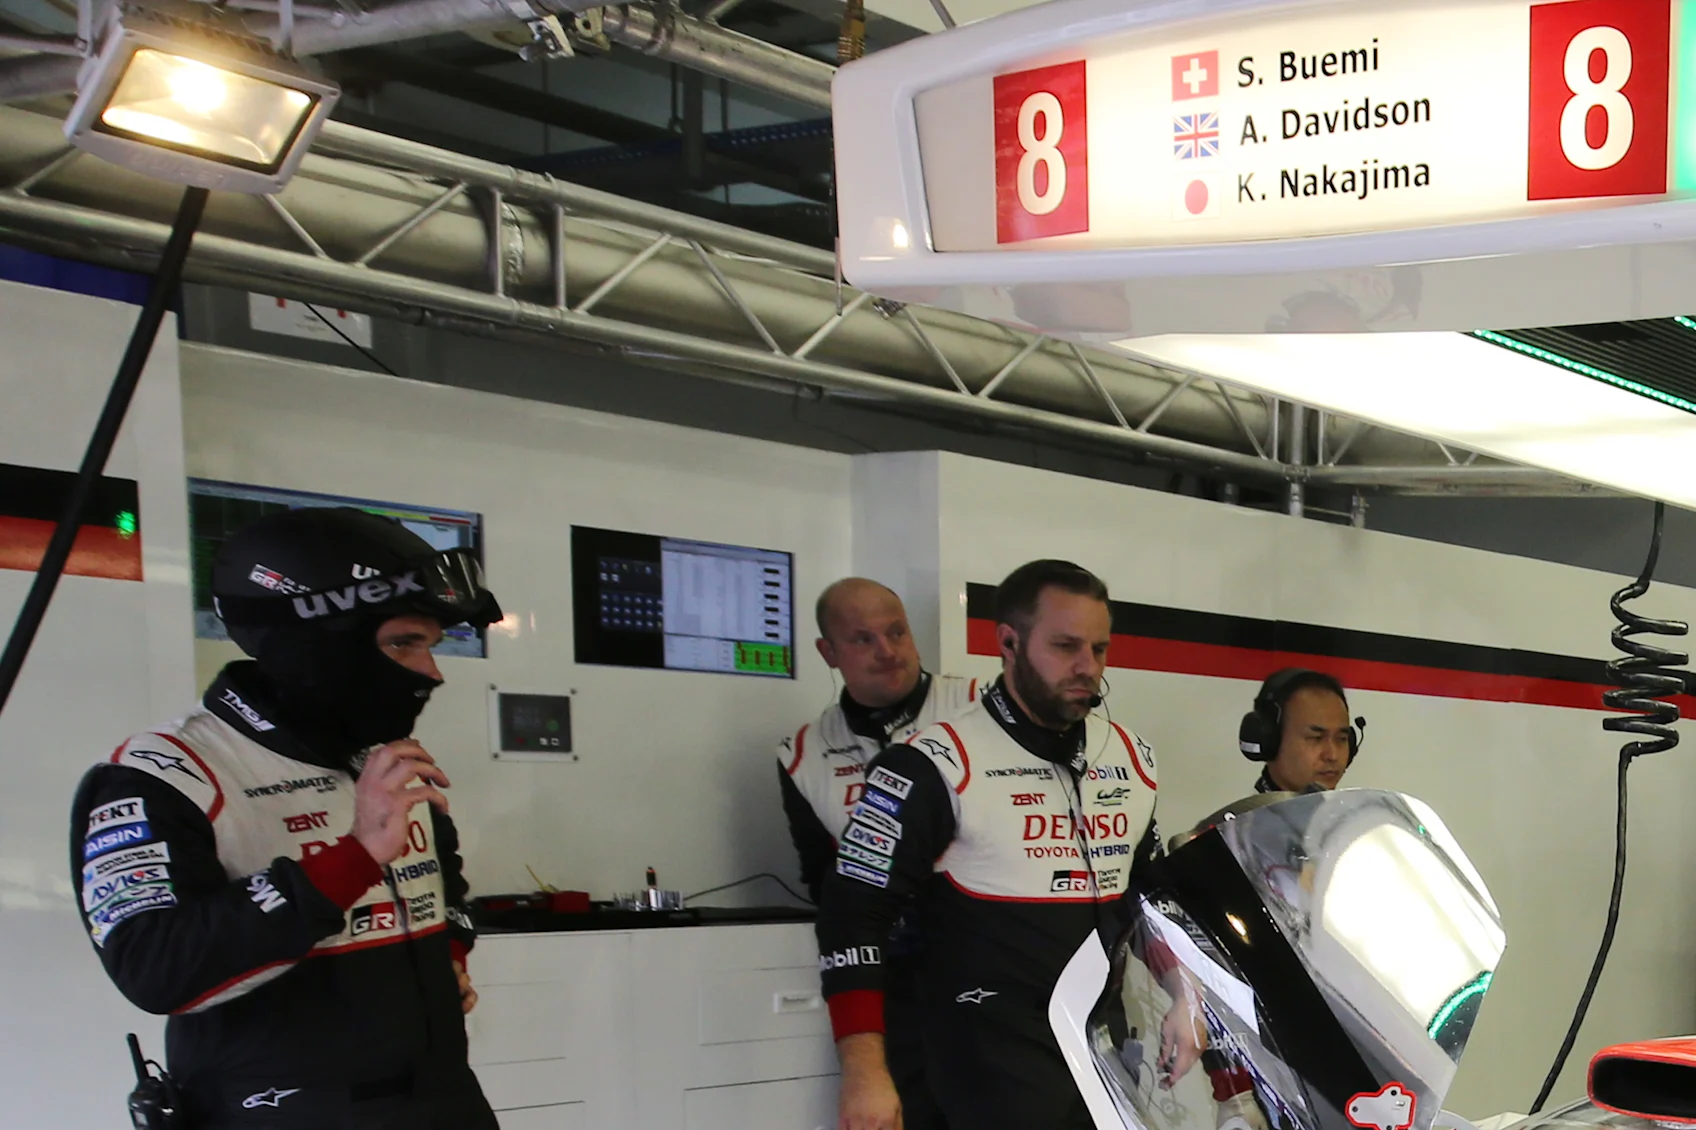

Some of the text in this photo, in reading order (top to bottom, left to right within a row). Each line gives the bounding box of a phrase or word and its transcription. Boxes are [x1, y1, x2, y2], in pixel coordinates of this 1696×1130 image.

[1238, 38, 1380, 88] S. Buemi
[1559, 26, 1634, 170] 8
[1240, 95, 1432, 145] A. Davidson
[1016, 91, 1067, 215] 8
[1237, 162, 1431, 202] K. Nakajima
[293, 571, 424, 619] uvex
[1086, 767, 1117, 781] obil
[89, 802, 139, 823] TEKT
[1010, 793, 1046, 806] ZENT
[283, 811, 329, 833] ZENT
[1023, 812, 1128, 842] DENSO
[86, 826, 143, 857] AISIN
[1024, 844, 1130, 859] TOYOTA HBRID
[1051, 878, 1087, 892] GR
[353, 914, 396, 935] GR
